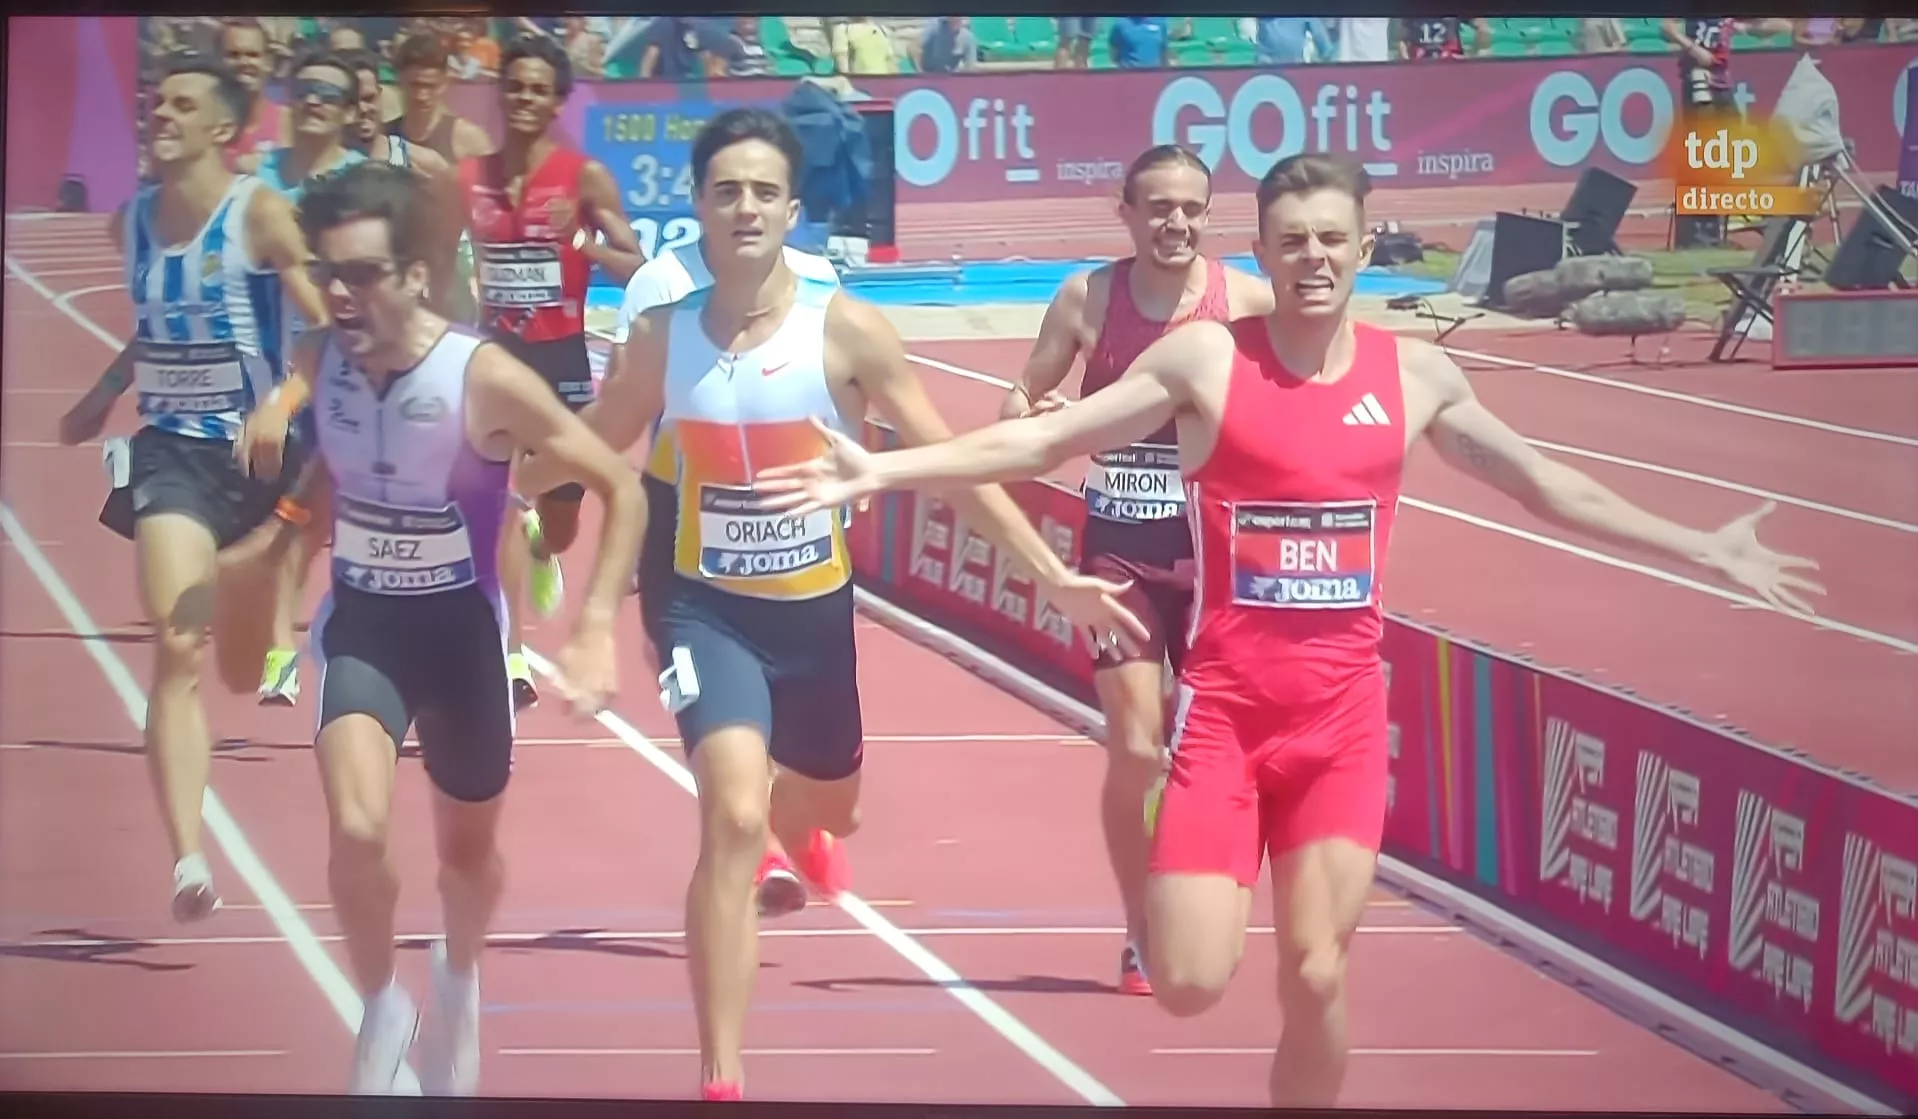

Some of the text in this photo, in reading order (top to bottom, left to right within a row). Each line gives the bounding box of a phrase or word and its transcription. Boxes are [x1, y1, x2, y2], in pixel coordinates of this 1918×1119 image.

[1420, 23, 1446, 43] 12
[1417, 150, 1495, 178] inspira
[628, 154, 693, 206] 3:4
[155, 368, 214, 388] TORRE
[1104, 472, 1167, 494] MIRON
[725, 517, 807, 543] ORIACH
[368, 537, 422, 561] SAEZ
[1280, 538, 1337, 572] BEN
